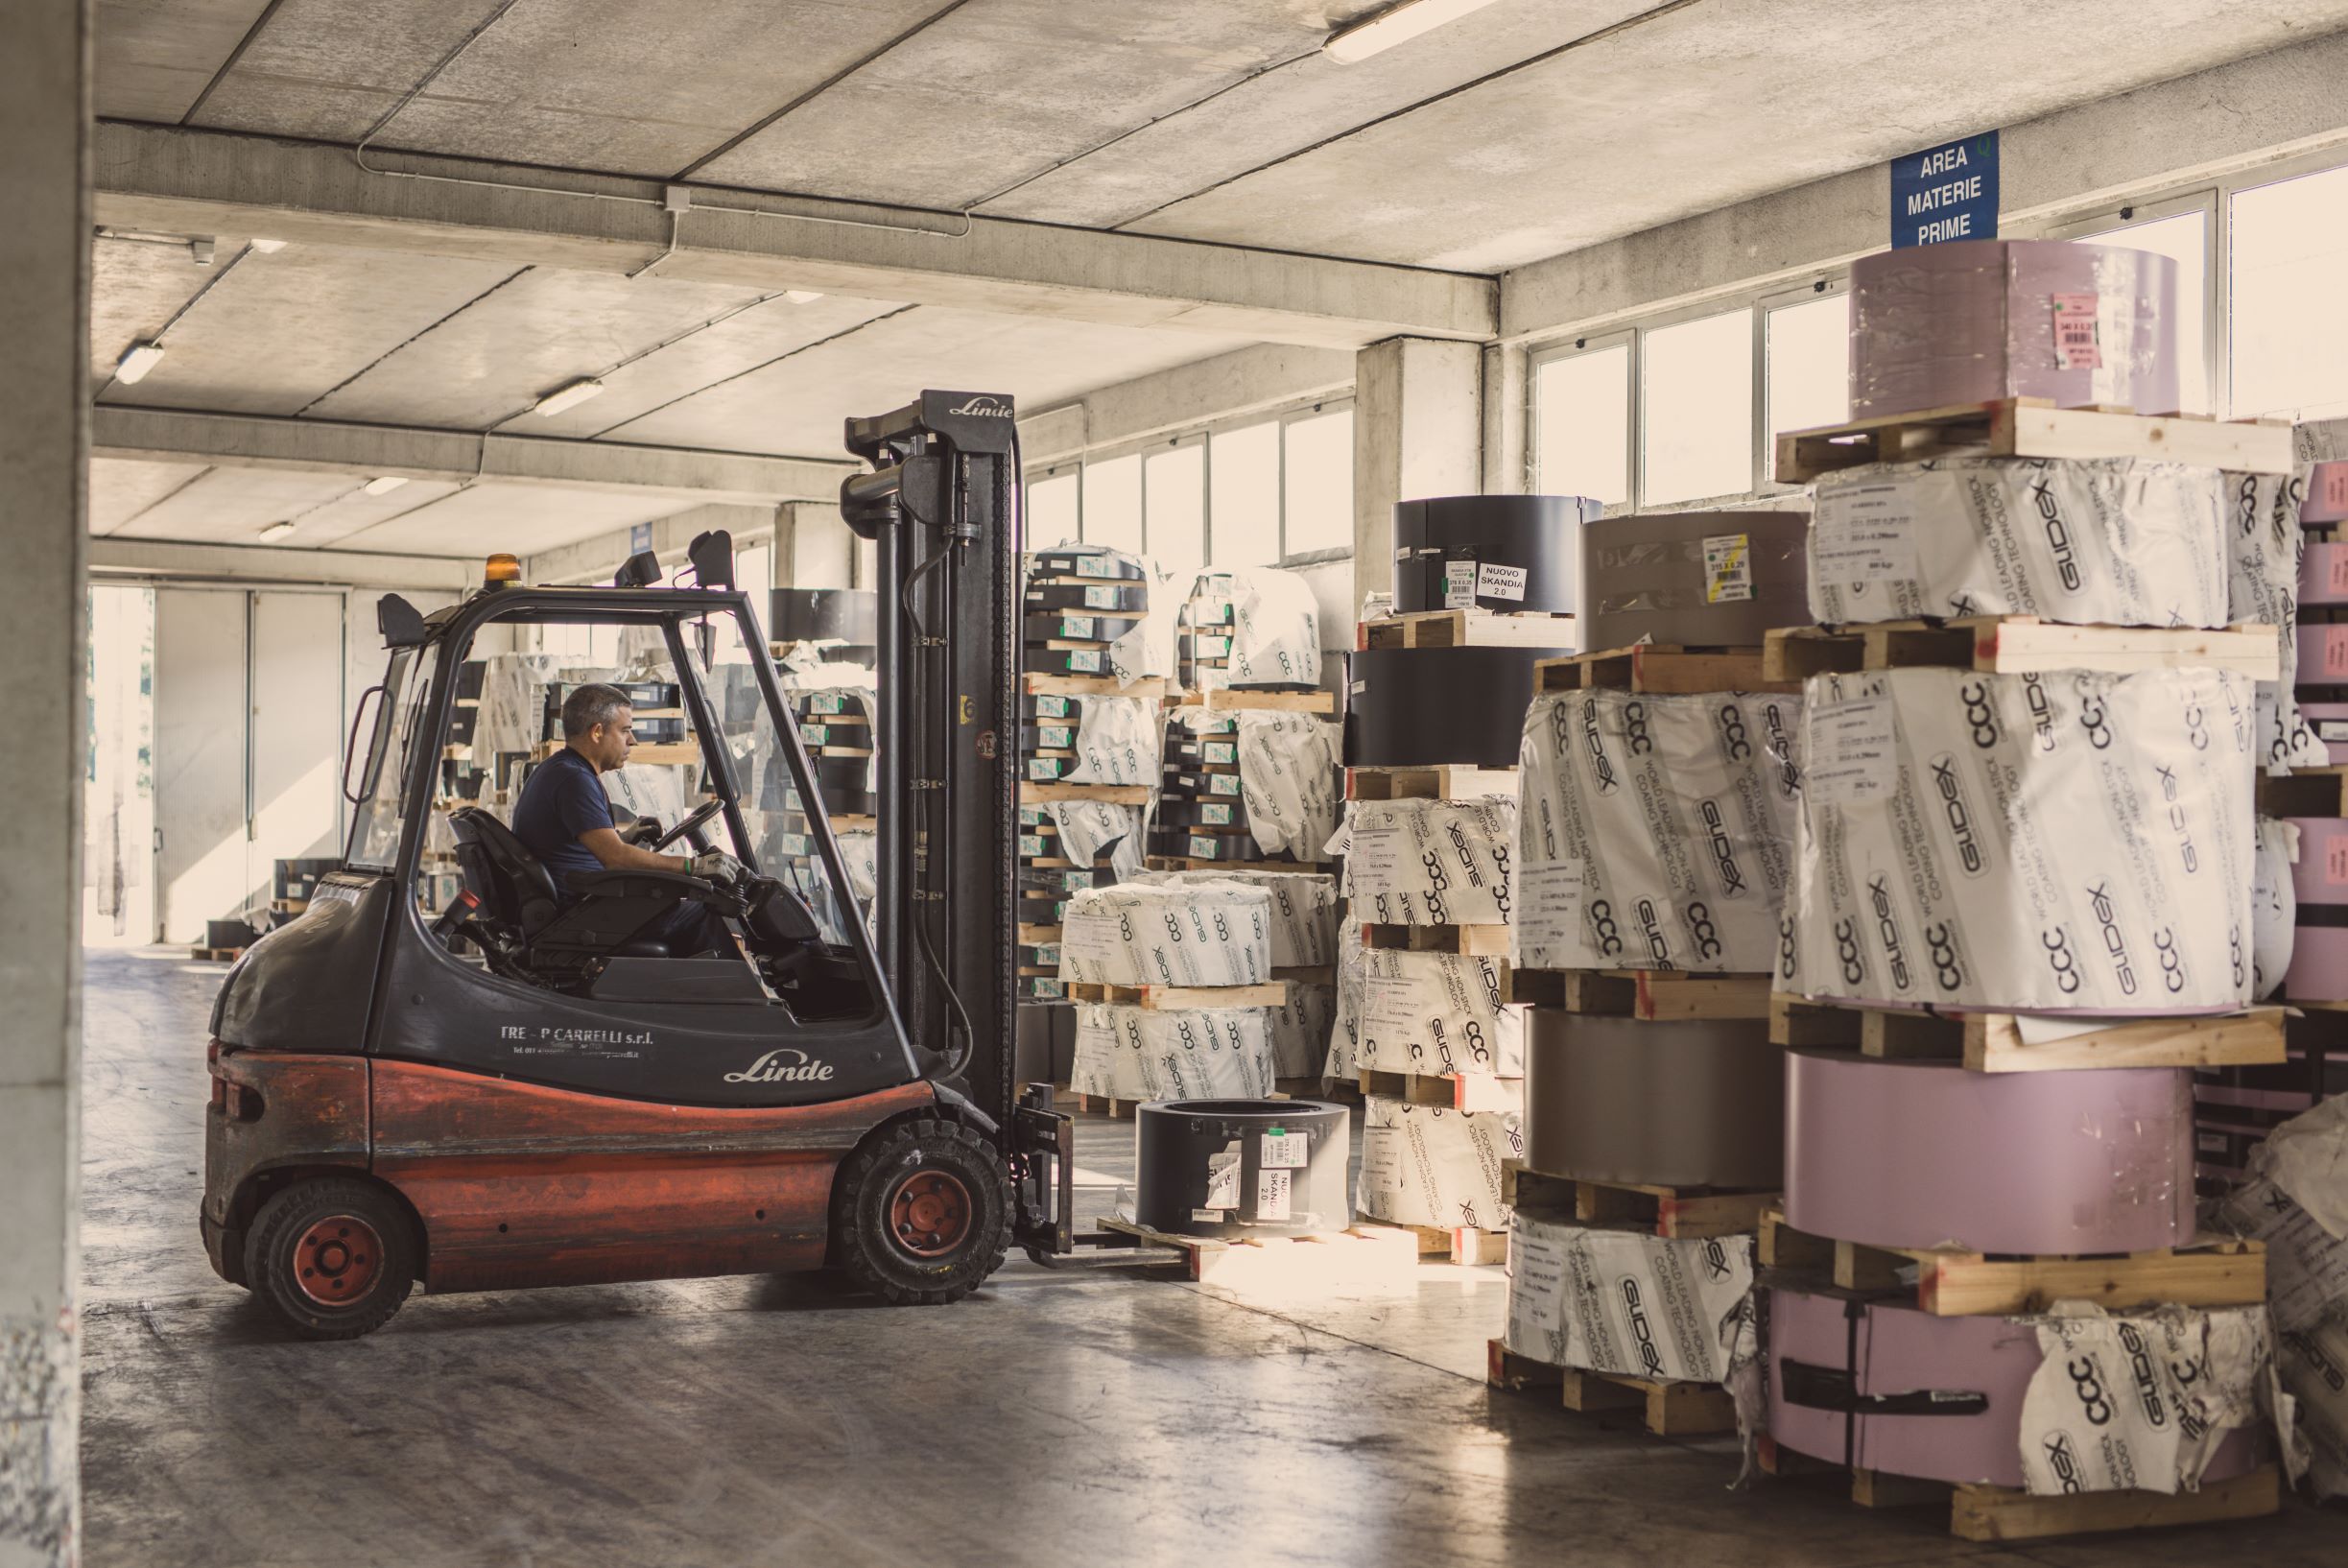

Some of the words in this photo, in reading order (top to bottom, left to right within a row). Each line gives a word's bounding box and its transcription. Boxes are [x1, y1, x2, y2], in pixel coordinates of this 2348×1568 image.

[1920, 146, 1968, 178] AREA
[1908, 176, 1981, 216] MATERIE
[1918, 213, 1971, 246] PRIME
[949, 396, 1014, 418] Linde
[2305, 430, 2318, 462] WORLD
[1967, 473, 1994, 535] NON-STICK
[1986, 481, 2018, 564] TECHNOLOGY
[1988, 535, 2013, 588] LEADING
[2030, 479, 2081, 591] GLIDEX
[1481, 576, 1524, 589] SKANDIA
[1485, 567, 1519, 578] NUOVO
[1279, 652, 1293, 675] CCC
[1554, 701, 1569, 755] CCC
[1625, 701, 1651, 755] CCC
[1720, 704, 1750, 761] CCC
[1961, 681, 1997, 748] CCC
[1584, 699, 1618, 791] GLIDEX
[1645, 759, 1664, 798] WORLD
[1657, 797, 1679, 846] LEADING
[1932, 757, 1981, 872] GLIDEX
[1986, 756, 2011, 821] NON-STICK
[1541, 797, 1555, 860] GLID
[1635, 773, 1658, 822] COATING
[1652, 820, 1682, 891] TECHNOLOGY
[1737, 777, 1755, 824] COATING
[1749, 821, 1780, 891] TECHNOLOGY
[1898, 819, 1919, 873] LEADING
[2156, 766, 2197, 873] GLIDEX
[1422, 850, 1447, 891] CCC
[1579, 840, 1601, 894] NON-STICK
[1701, 800, 1746, 894] GLIDEX
[1918, 843, 1943, 901] COATING
[1913, 872, 1933, 917] WORLD
[2032, 848, 2058, 904] COATING
[1165, 914, 1182, 942] CCC
[1213, 913, 1228, 941] CCC
[1278, 890, 1292, 917] CCC
[1424, 891, 1446, 925] CCC
[1591, 899, 1623, 957] CCC
[1687, 901, 1721, 960] CCC
[1836, 917, 1862, 985] CCC
[1869, 876, 1909, 989] GLIDEX
[1927, 922, 1961, 990] CCC
[2043, 926, 2079, 993] CCC
[2087, 882, 2136, 994] GLIDEX
[2154, 927, 2184, 992] CCC
[1440, 960, 1462, 1012] TECHNOLOGY
[1455, 976, 1473, 1016] NON-STICK
[1127, 1019, 1142, 1050] CCC
[1178, 1021, 1195, 1050] CCC
[1227, 1021, 1242, 1050] CCC
[1466, 1020, 1489, 1063] CCC
[723, 1048, 835, 1083] Linde
[1407, 1119, 1420, 1158] NON-STICK
[1414, 1125, 1432, 1176] TECHNOLOGY
[1468, 1123, 1484, 1163] NON-STICK
[1482, 1162, 1500, 1198] LEADING
[1494, 1197, 1506, 1220] ORLD
[1578, 1296, 1606, 1369] TECHNOLOGY
[1623, 1279, 1665, 1376] GLIDEX
[1654, 1256, 1676, 1305] COATING
[1671, 1304, 1701, 1379] TECHNOLOGY
[1664, 1242, 1682, 1280] WORLD
[1676, 1279, 1697, 1328] LEADING
[1692, 1328, 1714, 1382] NON-STIC
[1594, 1315, 1619, 1370] NON-STIC
[2069, 1356, 2110, 1426] CCC
